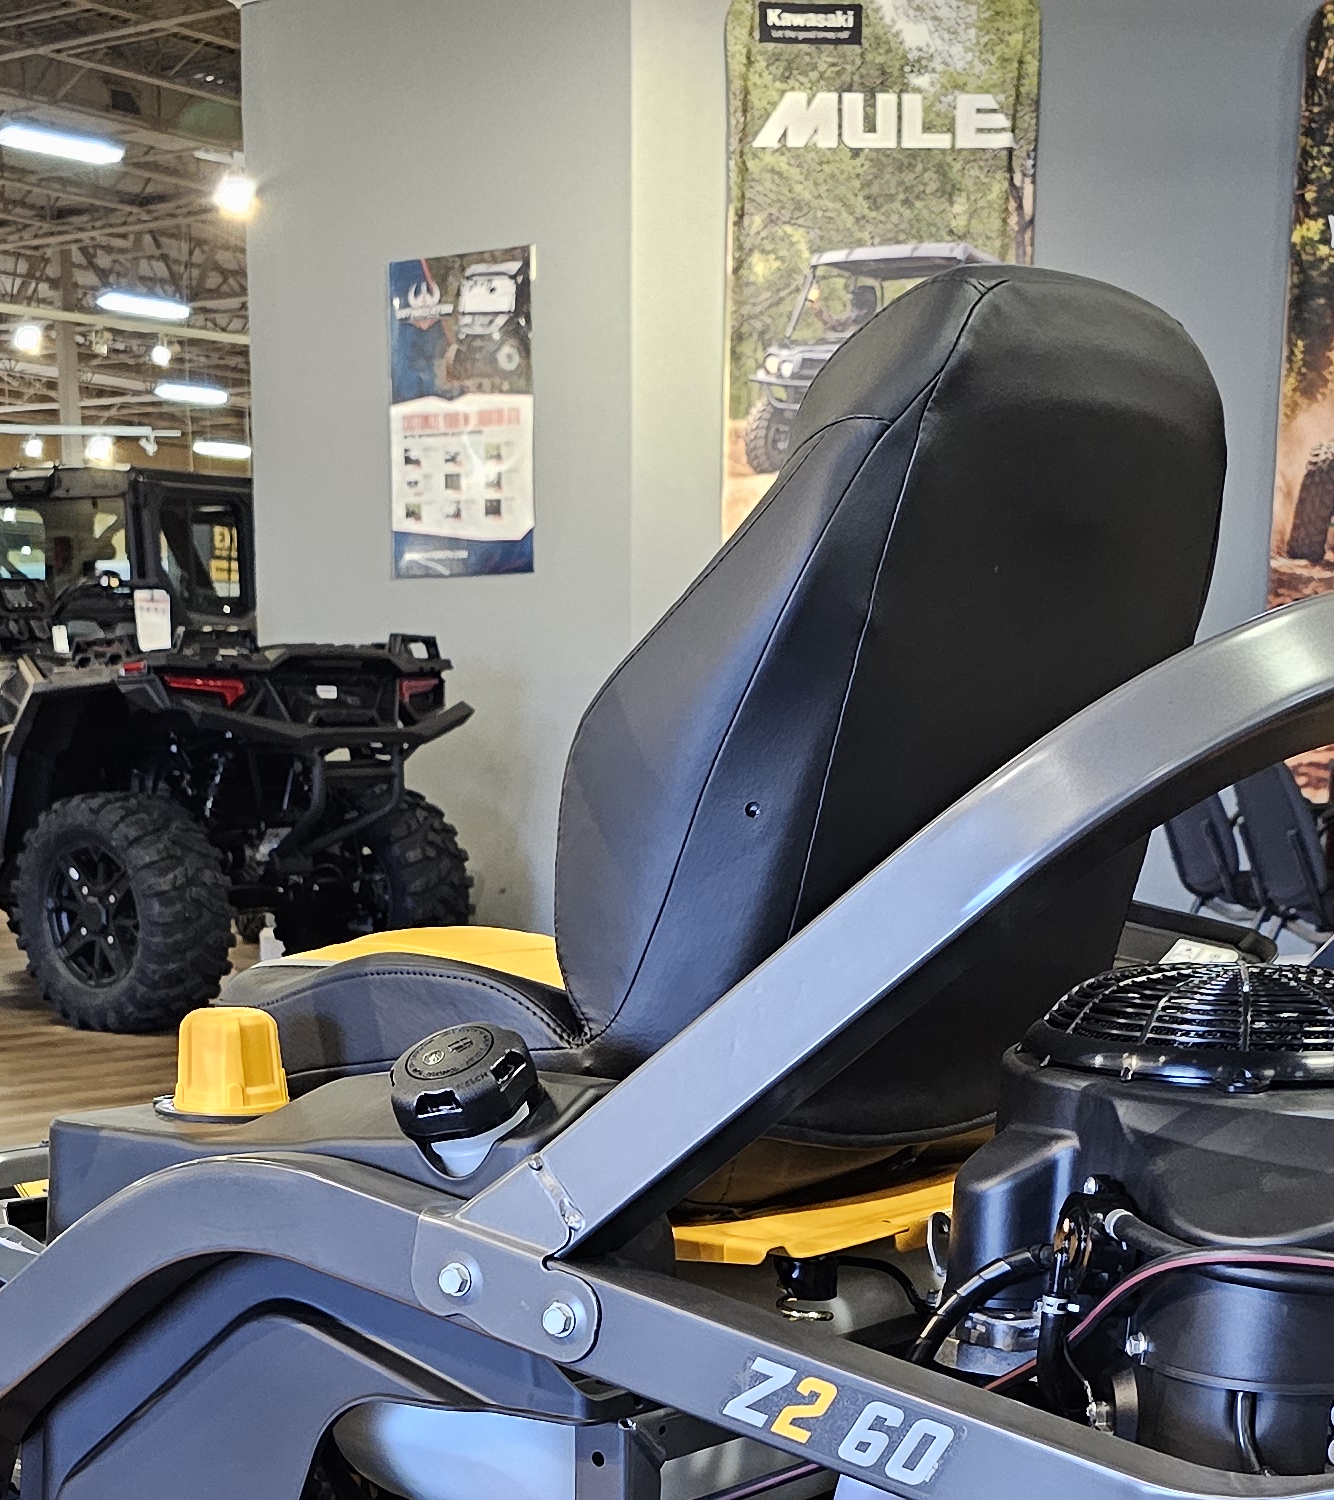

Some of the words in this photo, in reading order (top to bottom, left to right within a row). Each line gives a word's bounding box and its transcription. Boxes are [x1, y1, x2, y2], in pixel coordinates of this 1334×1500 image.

[766, 8, 854, 28] Kawasaki
[751, 91, 1017, 150] MULE
[722, 1355, 839, 1445] Z2
[837, 1400, 955, 1486] 60
